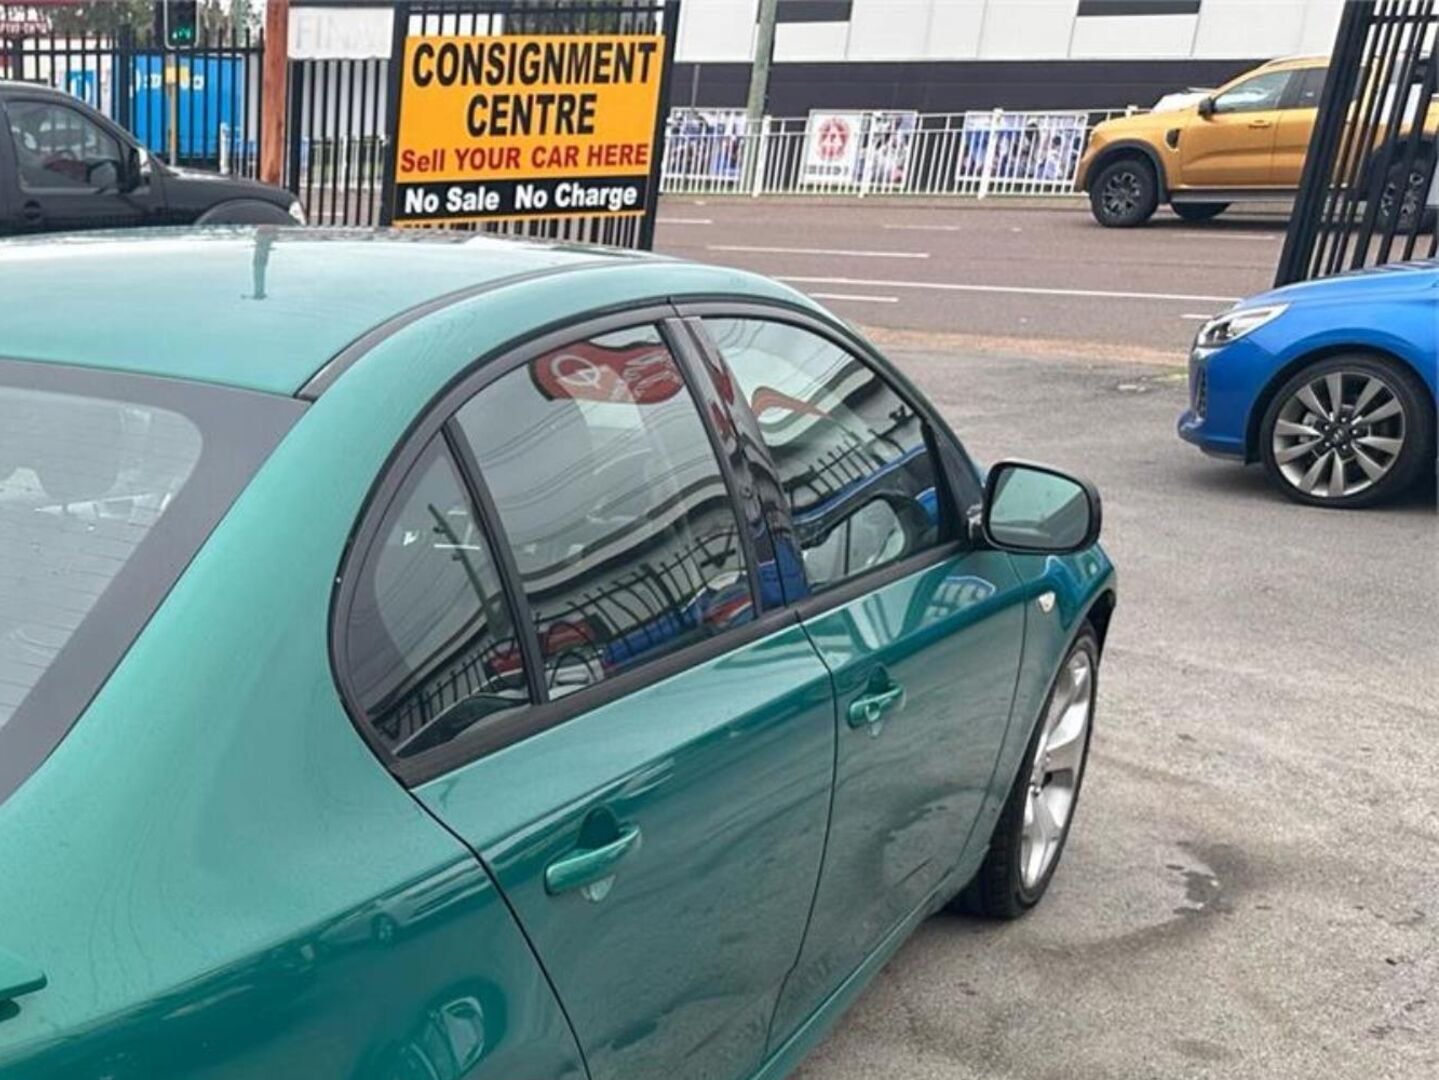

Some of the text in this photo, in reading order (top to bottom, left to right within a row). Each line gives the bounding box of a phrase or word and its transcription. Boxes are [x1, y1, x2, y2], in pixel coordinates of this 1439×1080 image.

[412, 41, 657, 87] CONSIGNMENT
[467, 93, 597, 137] CENTRE
[400, 143, 648, 173] Sell YOUR CAR HERE
[404, 182, 638, 214] No Sale No Charge
